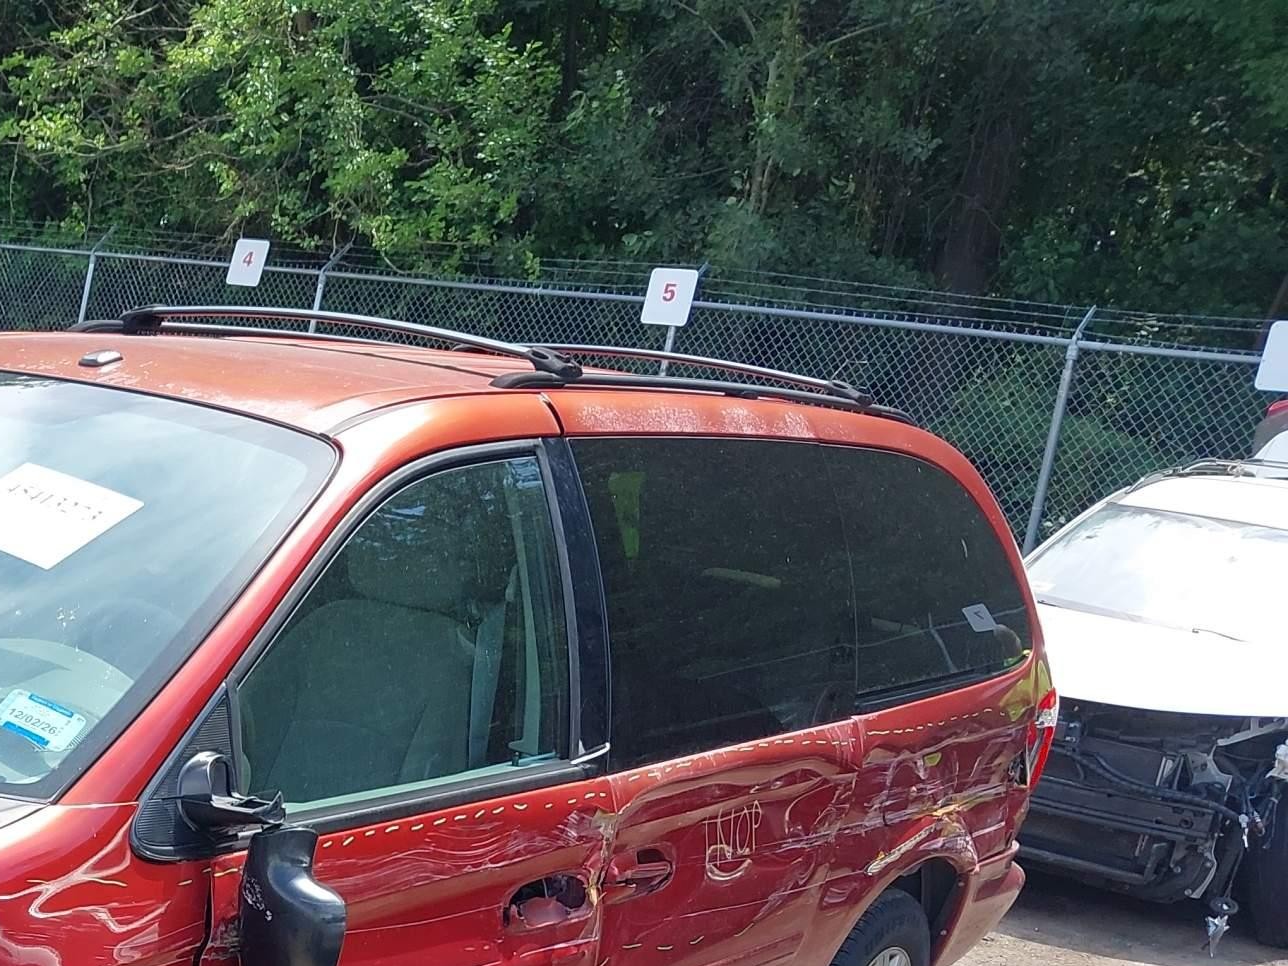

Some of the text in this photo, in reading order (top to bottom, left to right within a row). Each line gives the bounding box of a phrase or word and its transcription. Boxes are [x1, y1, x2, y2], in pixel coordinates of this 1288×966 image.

[242, 250, 255, 268] 4
[662, 282, 678, 302] 5
[7, 707, 59, 736] 12/02/26
